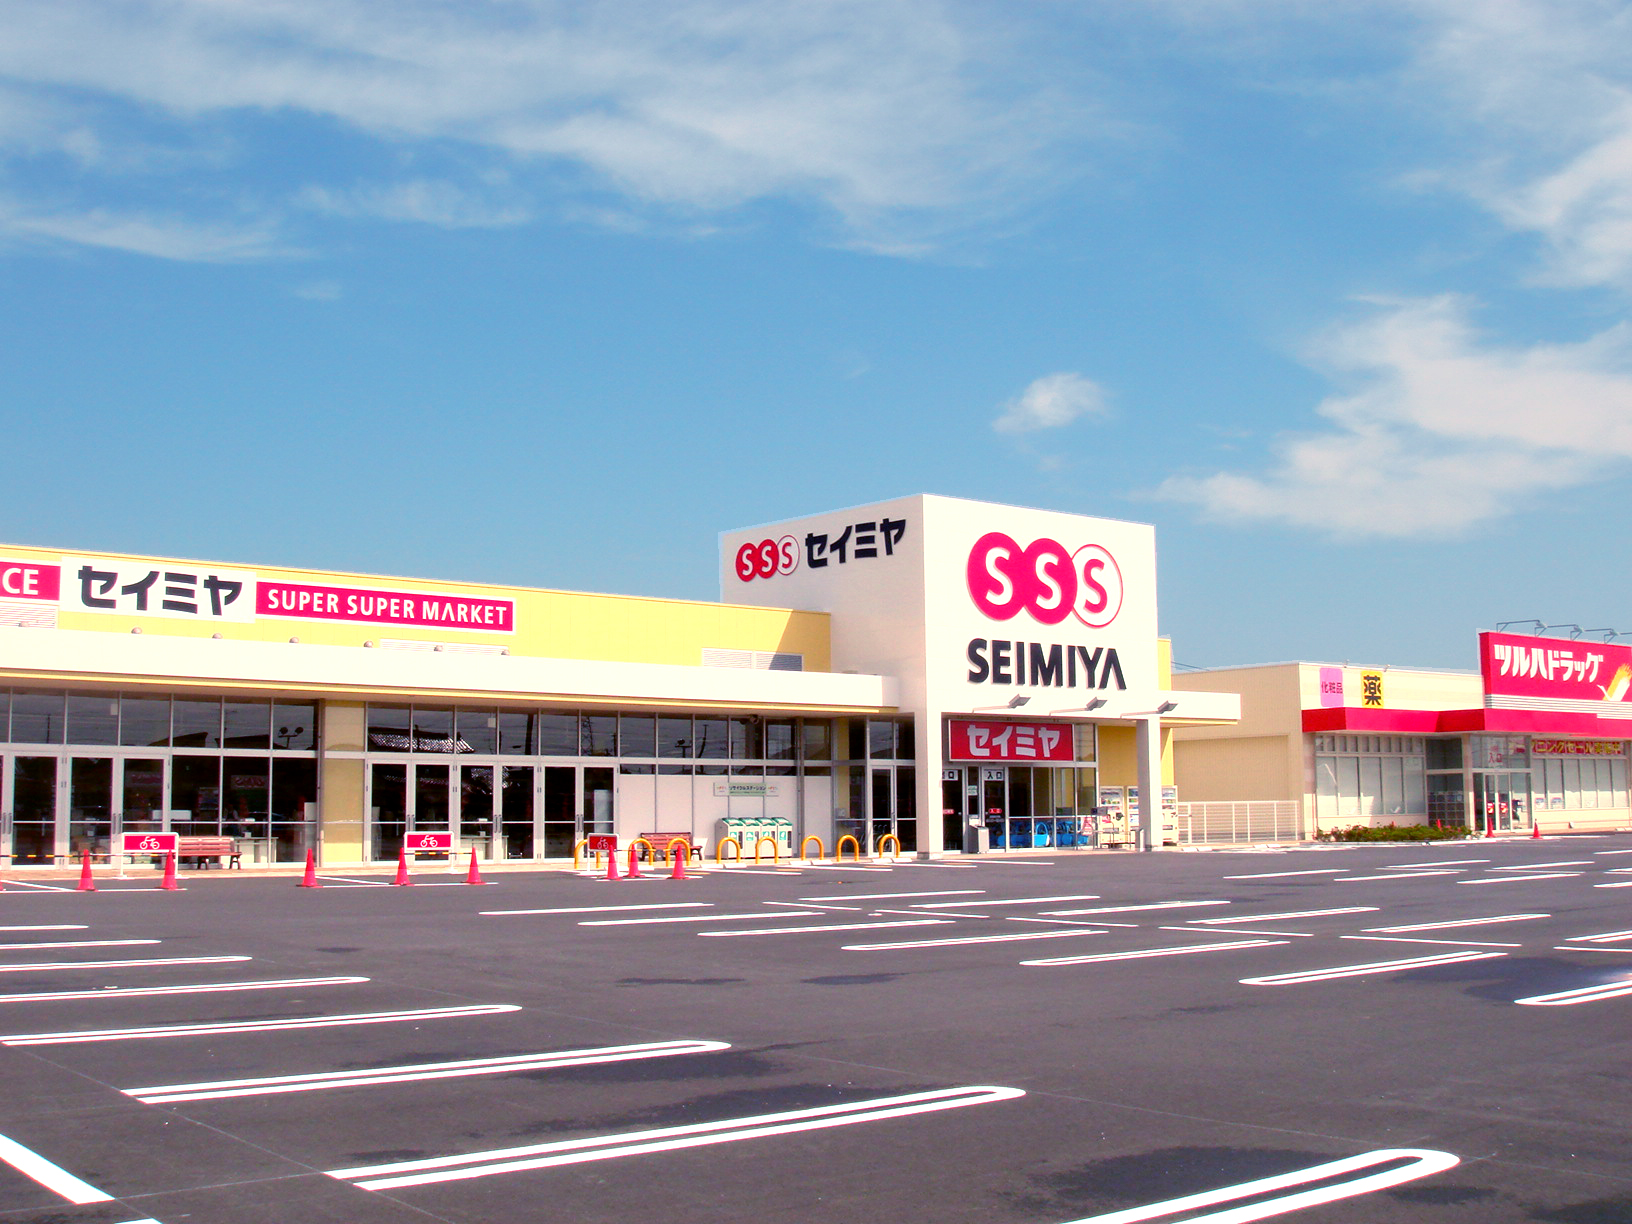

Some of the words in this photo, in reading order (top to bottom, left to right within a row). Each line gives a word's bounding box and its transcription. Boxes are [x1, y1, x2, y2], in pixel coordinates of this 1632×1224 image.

[804, 518, 907, 569] セイミヤ
[2, 567, 39, 595] CE
[77, 565, 243, 616] セイミヤ
[984, 546, 1109, 614] SSS
[267, 588, 340, 614] SUPER
[346, 594, 415, 619] SUPER
[421, 600, 507, 625] MARKET
[966, 637, 1128, 691] SEIMIYA
[1493, 644, 1605, 683] ツルハドラッグ
[1362, 674, 1382, 706] 薬
[966, 724, 1061, 758] セイミヤ
[987, 771, 1003, 780] 入口
